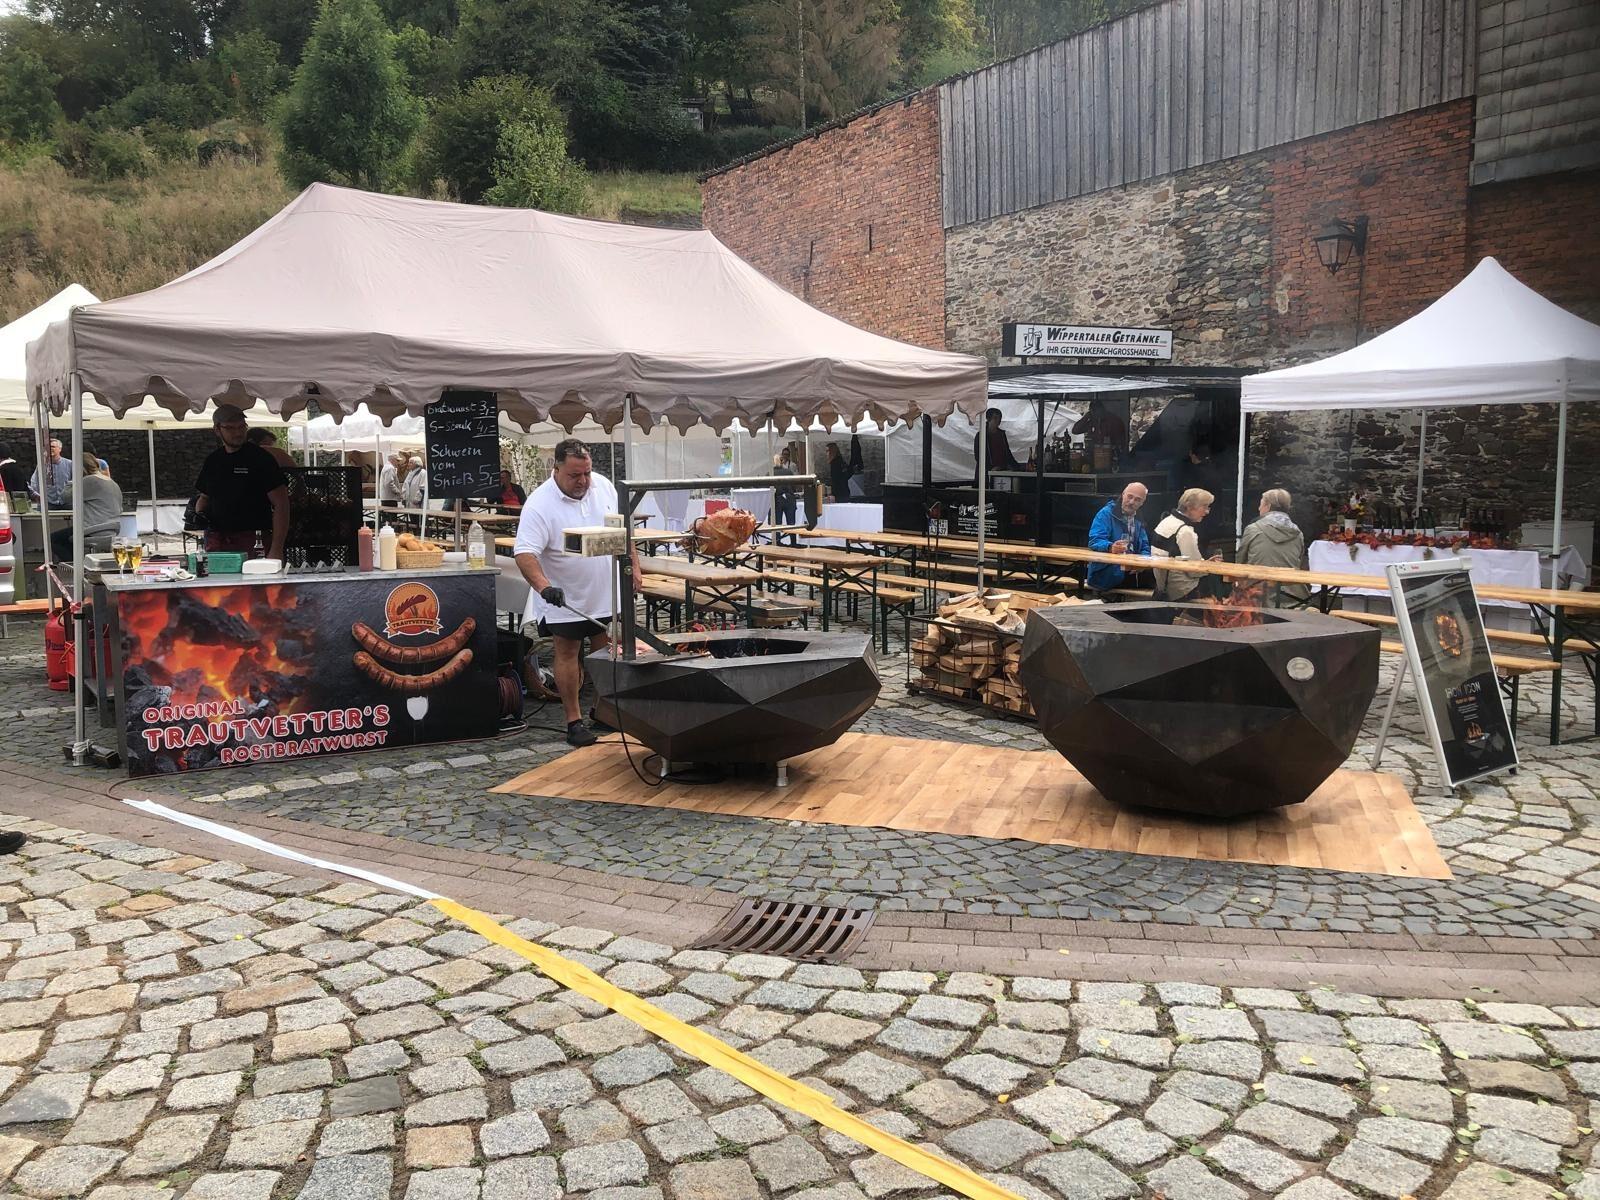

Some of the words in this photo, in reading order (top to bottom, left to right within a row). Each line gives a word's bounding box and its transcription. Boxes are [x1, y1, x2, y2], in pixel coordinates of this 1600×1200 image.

[1046, 346, 1059, 354] IHR
[1060, 346, 1159, 357] GETRÄNKEFACHGROSSHANDEL
[431, 444, 482, 457] Schwein
[432, 461, 456, 471] vom
[143, 700, 246, 724] ORIGINAL
[142, 704, 391, 751] TRAUTVETTER'S
[221, 730, 388, 764] ROSTBRATWURST
